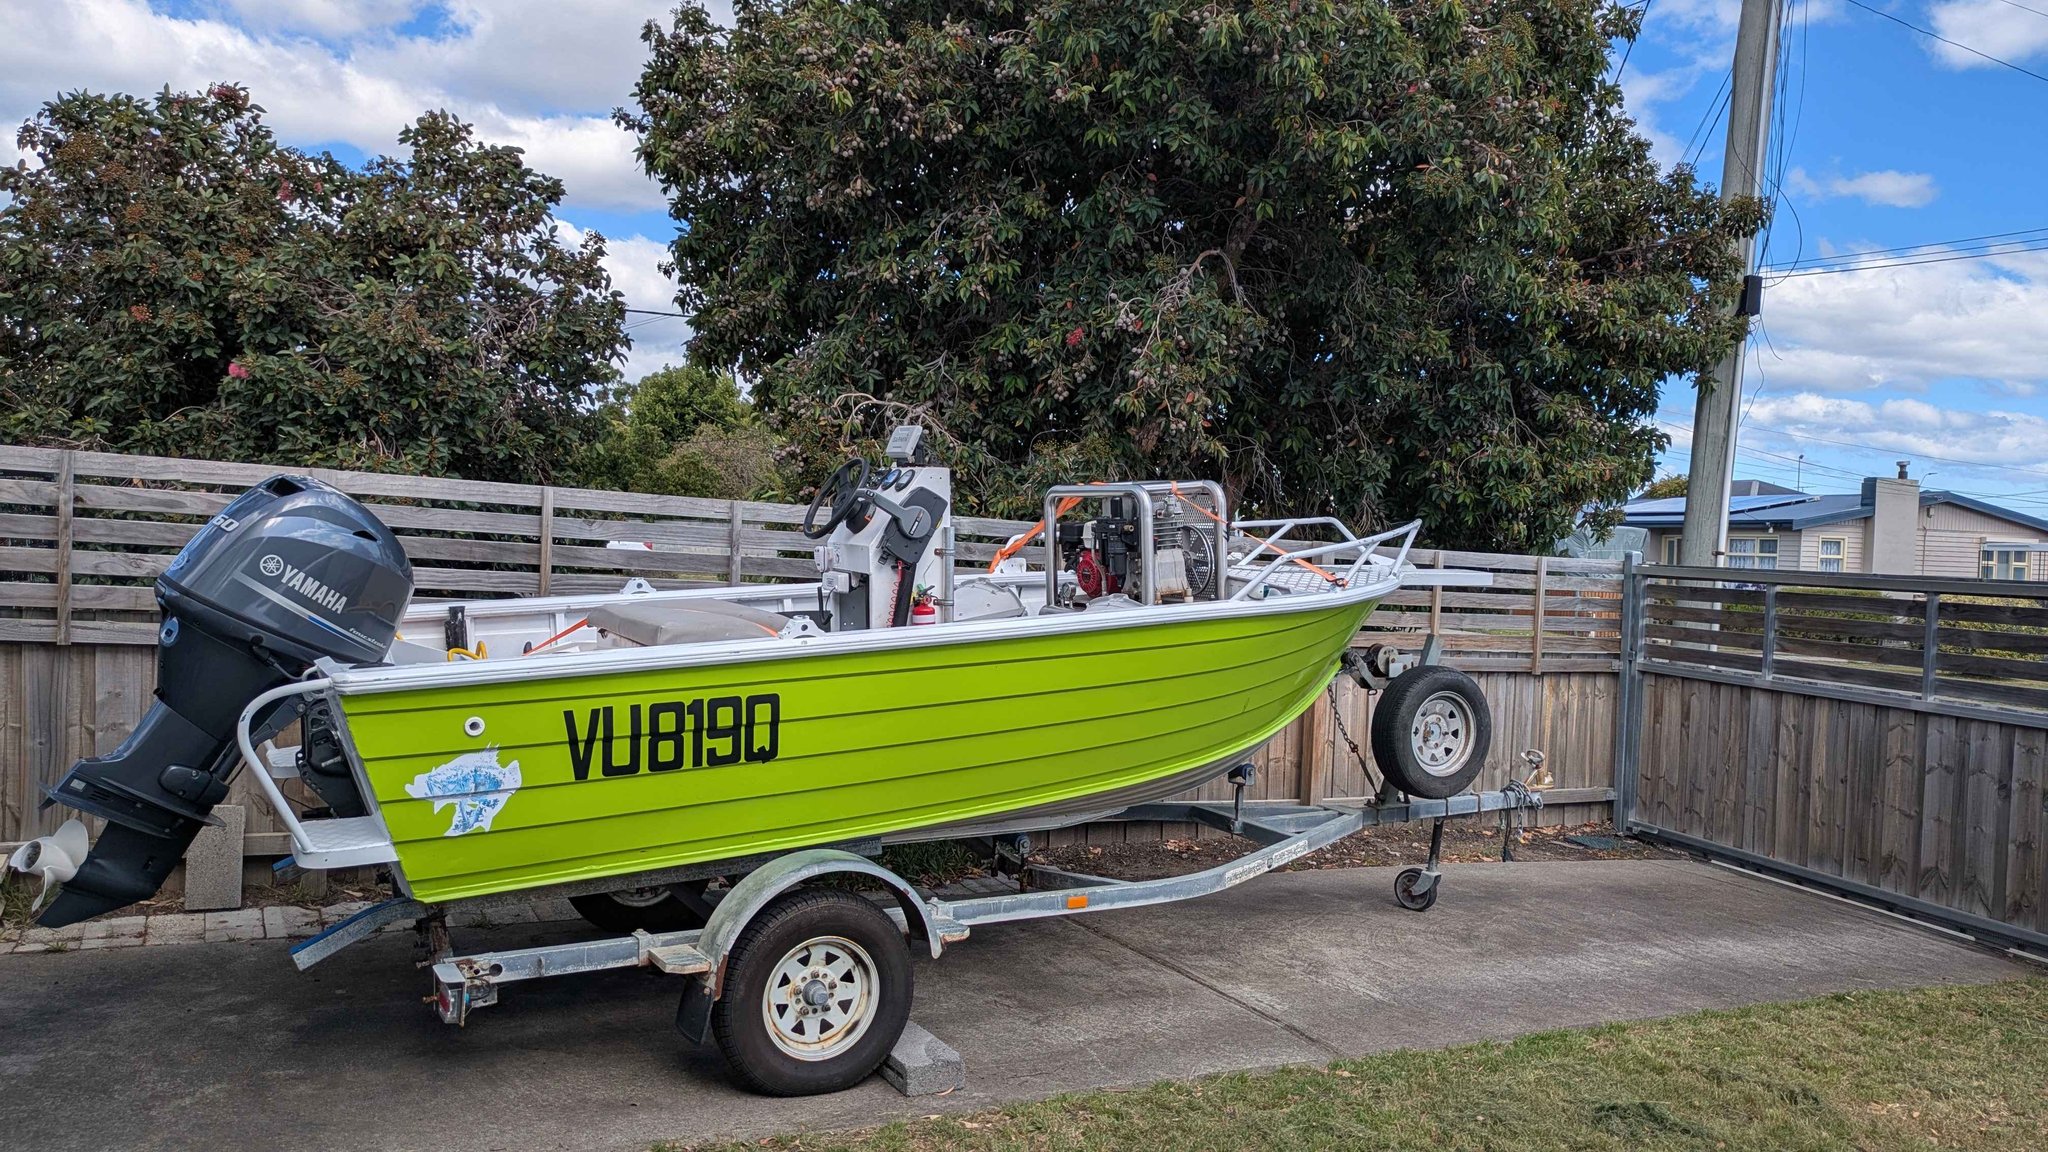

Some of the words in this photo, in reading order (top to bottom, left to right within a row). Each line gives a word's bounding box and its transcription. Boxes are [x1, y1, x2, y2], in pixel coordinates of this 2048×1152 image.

[212, 513, 240, 532] 60
[281, 564, 348, 614] YAMAHA
[563, 692, 781, 781] VU819Q
